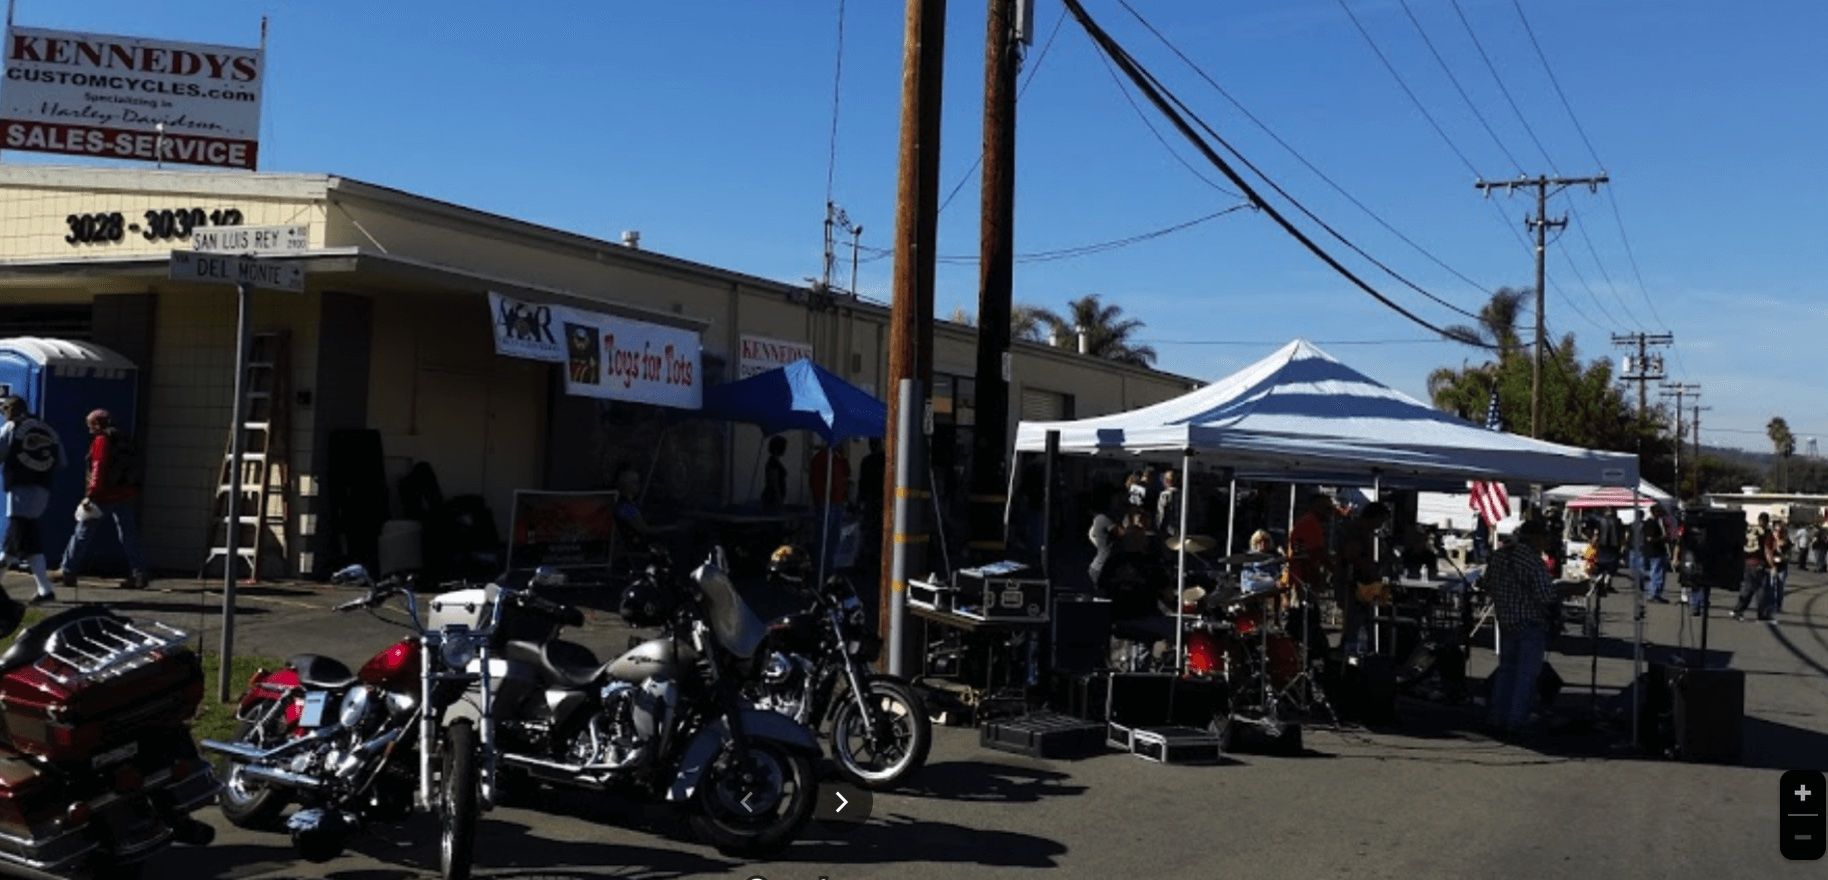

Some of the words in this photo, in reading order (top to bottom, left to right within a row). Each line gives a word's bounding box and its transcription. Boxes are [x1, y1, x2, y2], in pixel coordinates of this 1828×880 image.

[9, 34, 258, 83] KENNEDYS
[7, 67, 256, 102] CUSTOMCYCLES.com
[160, 99, 173, 108] in
[6, 124, 247, 165] SALES-SERVICE
[65, 211, 124, 243] 3028
[143, 207, 206, 240] 3030
[193, 232, 217, 251] SAN
[223, 231, 248, 250] LUIS
[255, 229, 280, 249] REY
[197, 257, 228, 278] DEL
[238, 261, 282, 285] MONTE
[604, 333, 640, 389] Toys
[642, 340, 662, 382] for
[664, 343, 693, 386] Tots
